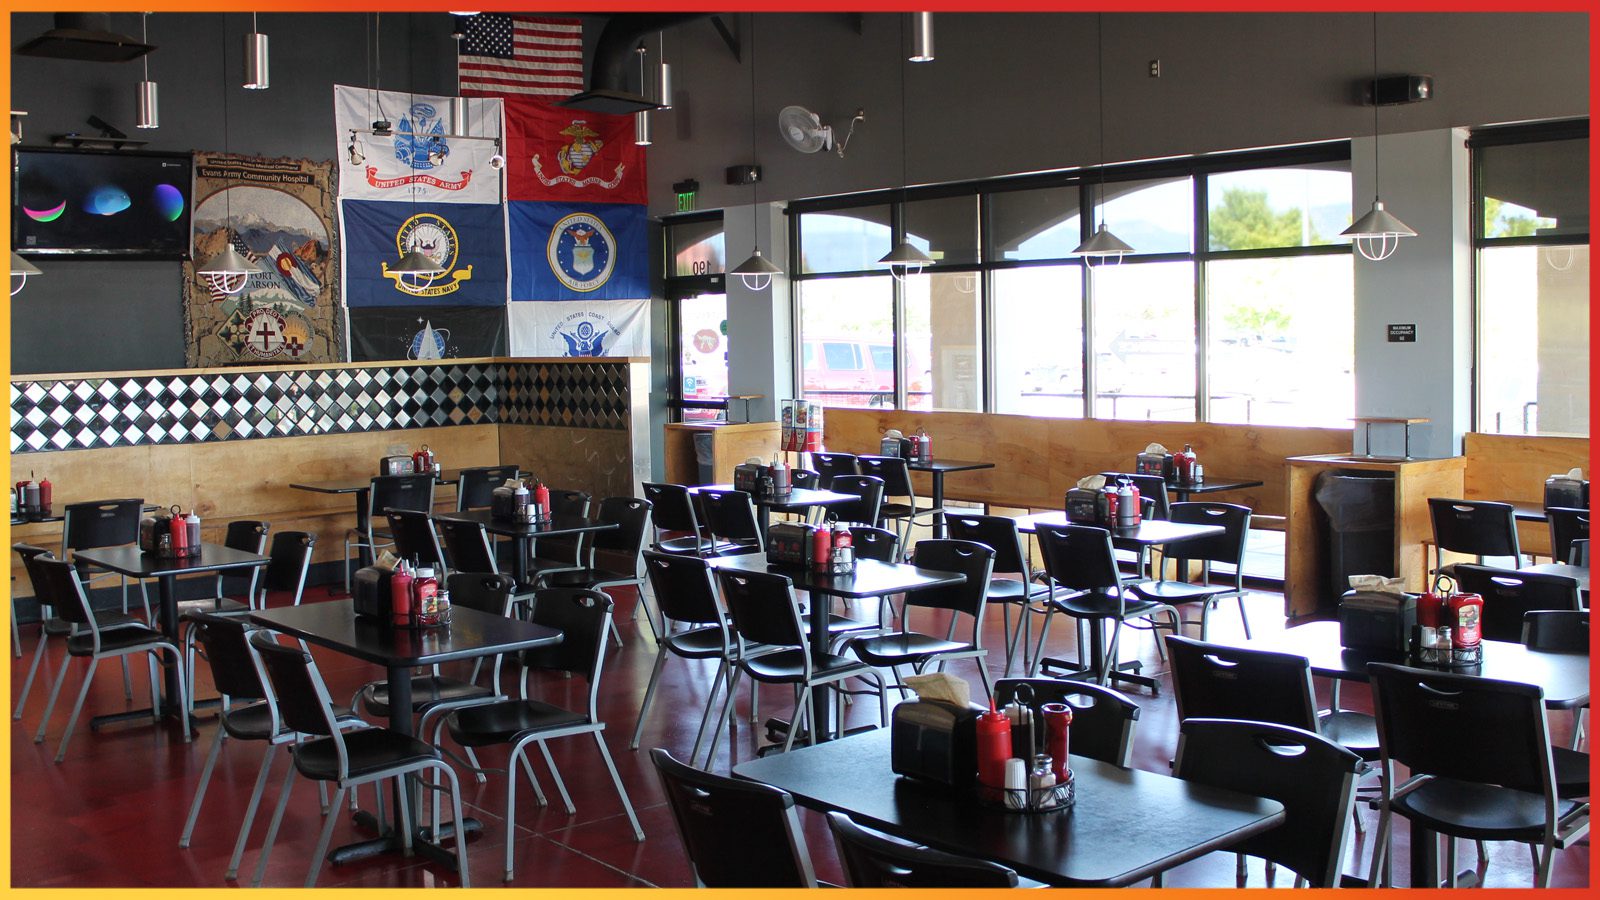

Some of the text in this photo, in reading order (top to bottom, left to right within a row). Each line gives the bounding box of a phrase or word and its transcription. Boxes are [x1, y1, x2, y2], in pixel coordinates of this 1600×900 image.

[201, 168, 309, 184] Evans Army Community Hospital
[375, 176, 463, 189] UNITED STATES ARMY
[556, 176, 577, 185] STATES
[582, 177, 602, 186] MARINE
[678, 192, 692, 211] EXIT
[435, 219, 455, 255] STATES
[442, 283, 458, 293] NAVY
[550, 312, 621, 339] UNITED STATES COAST GUARD
